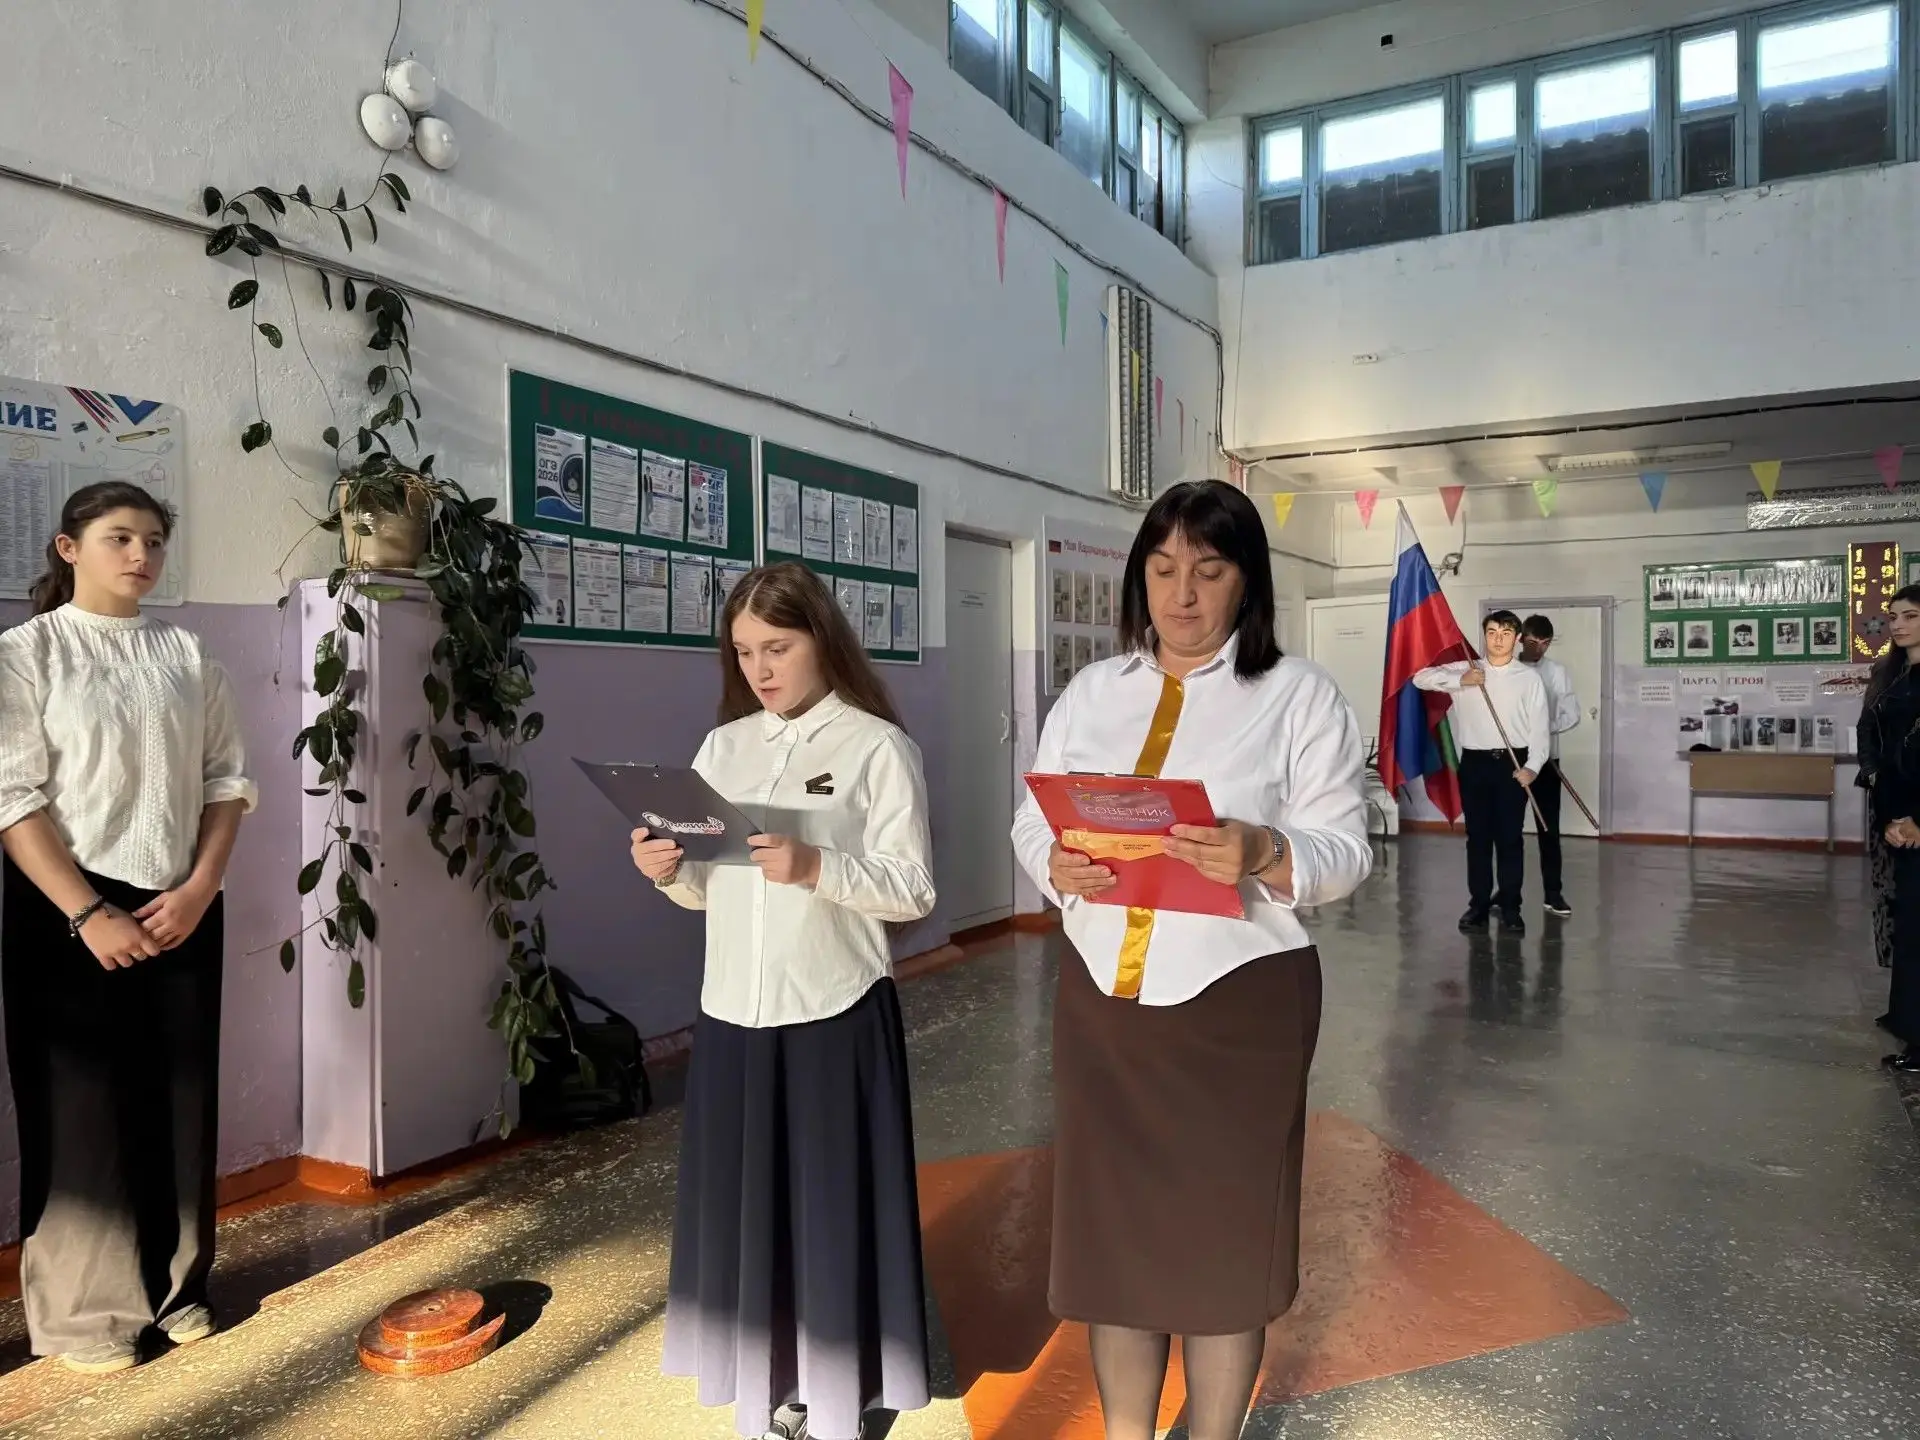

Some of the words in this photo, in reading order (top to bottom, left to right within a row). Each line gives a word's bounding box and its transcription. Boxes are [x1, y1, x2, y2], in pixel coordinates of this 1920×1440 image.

[0, 402, 57, 432] ИЕ
[539, 458, 557, 470] ОГЭ
[538, 469, 559, 482] 2026
[1682, 677, 1718, 686] ПАРТА
[1727, 676, 1764, 686] ГЕРОЯ
[1085, 806, 1170, 817] СОВЕТНИК
